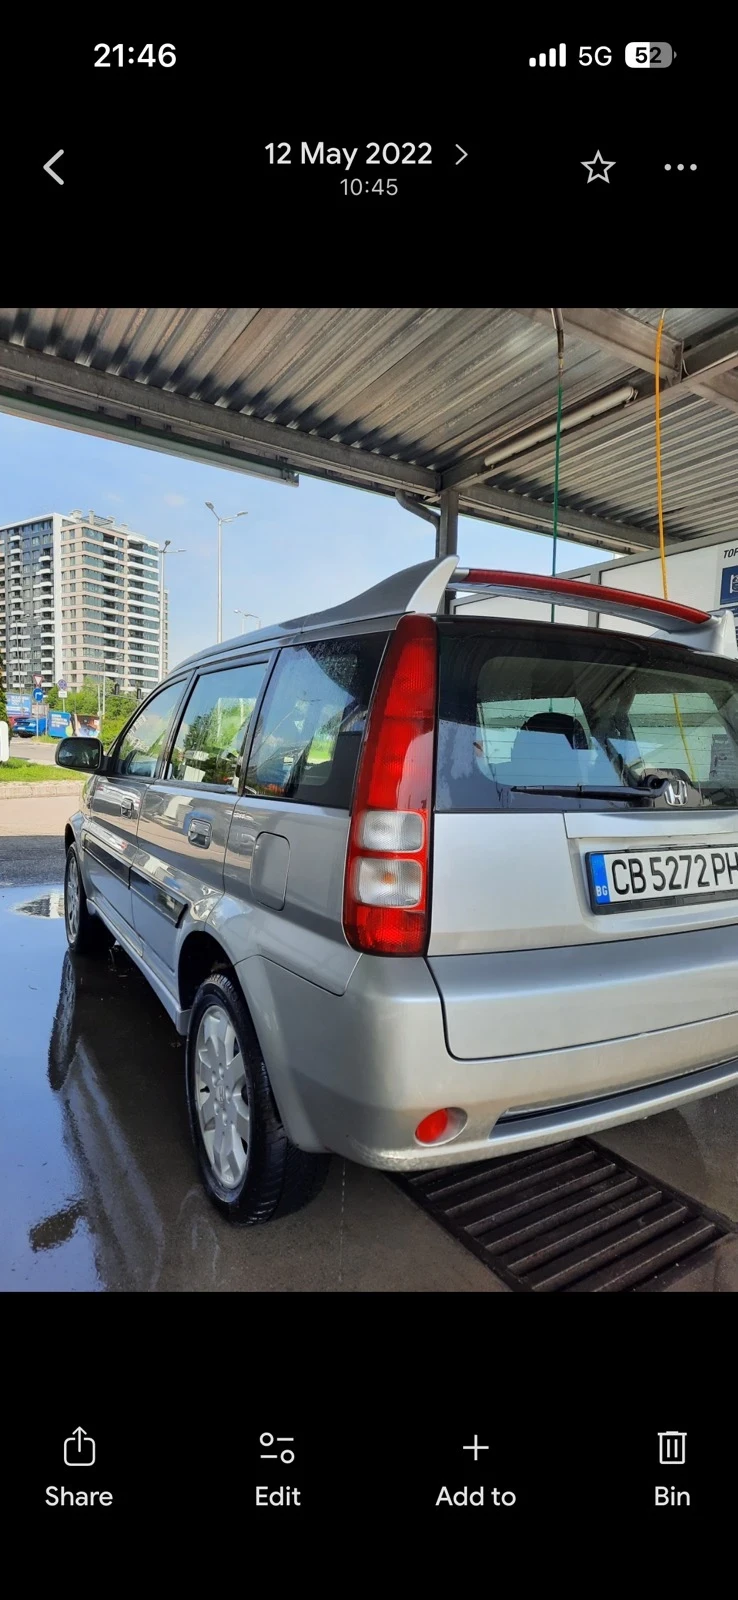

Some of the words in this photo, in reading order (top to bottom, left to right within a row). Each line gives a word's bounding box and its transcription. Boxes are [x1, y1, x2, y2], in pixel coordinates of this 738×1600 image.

[611, 858, 647, 895] CB
[649, 854, 710, 892] 5272
[596, 885, 609, 897] BG
